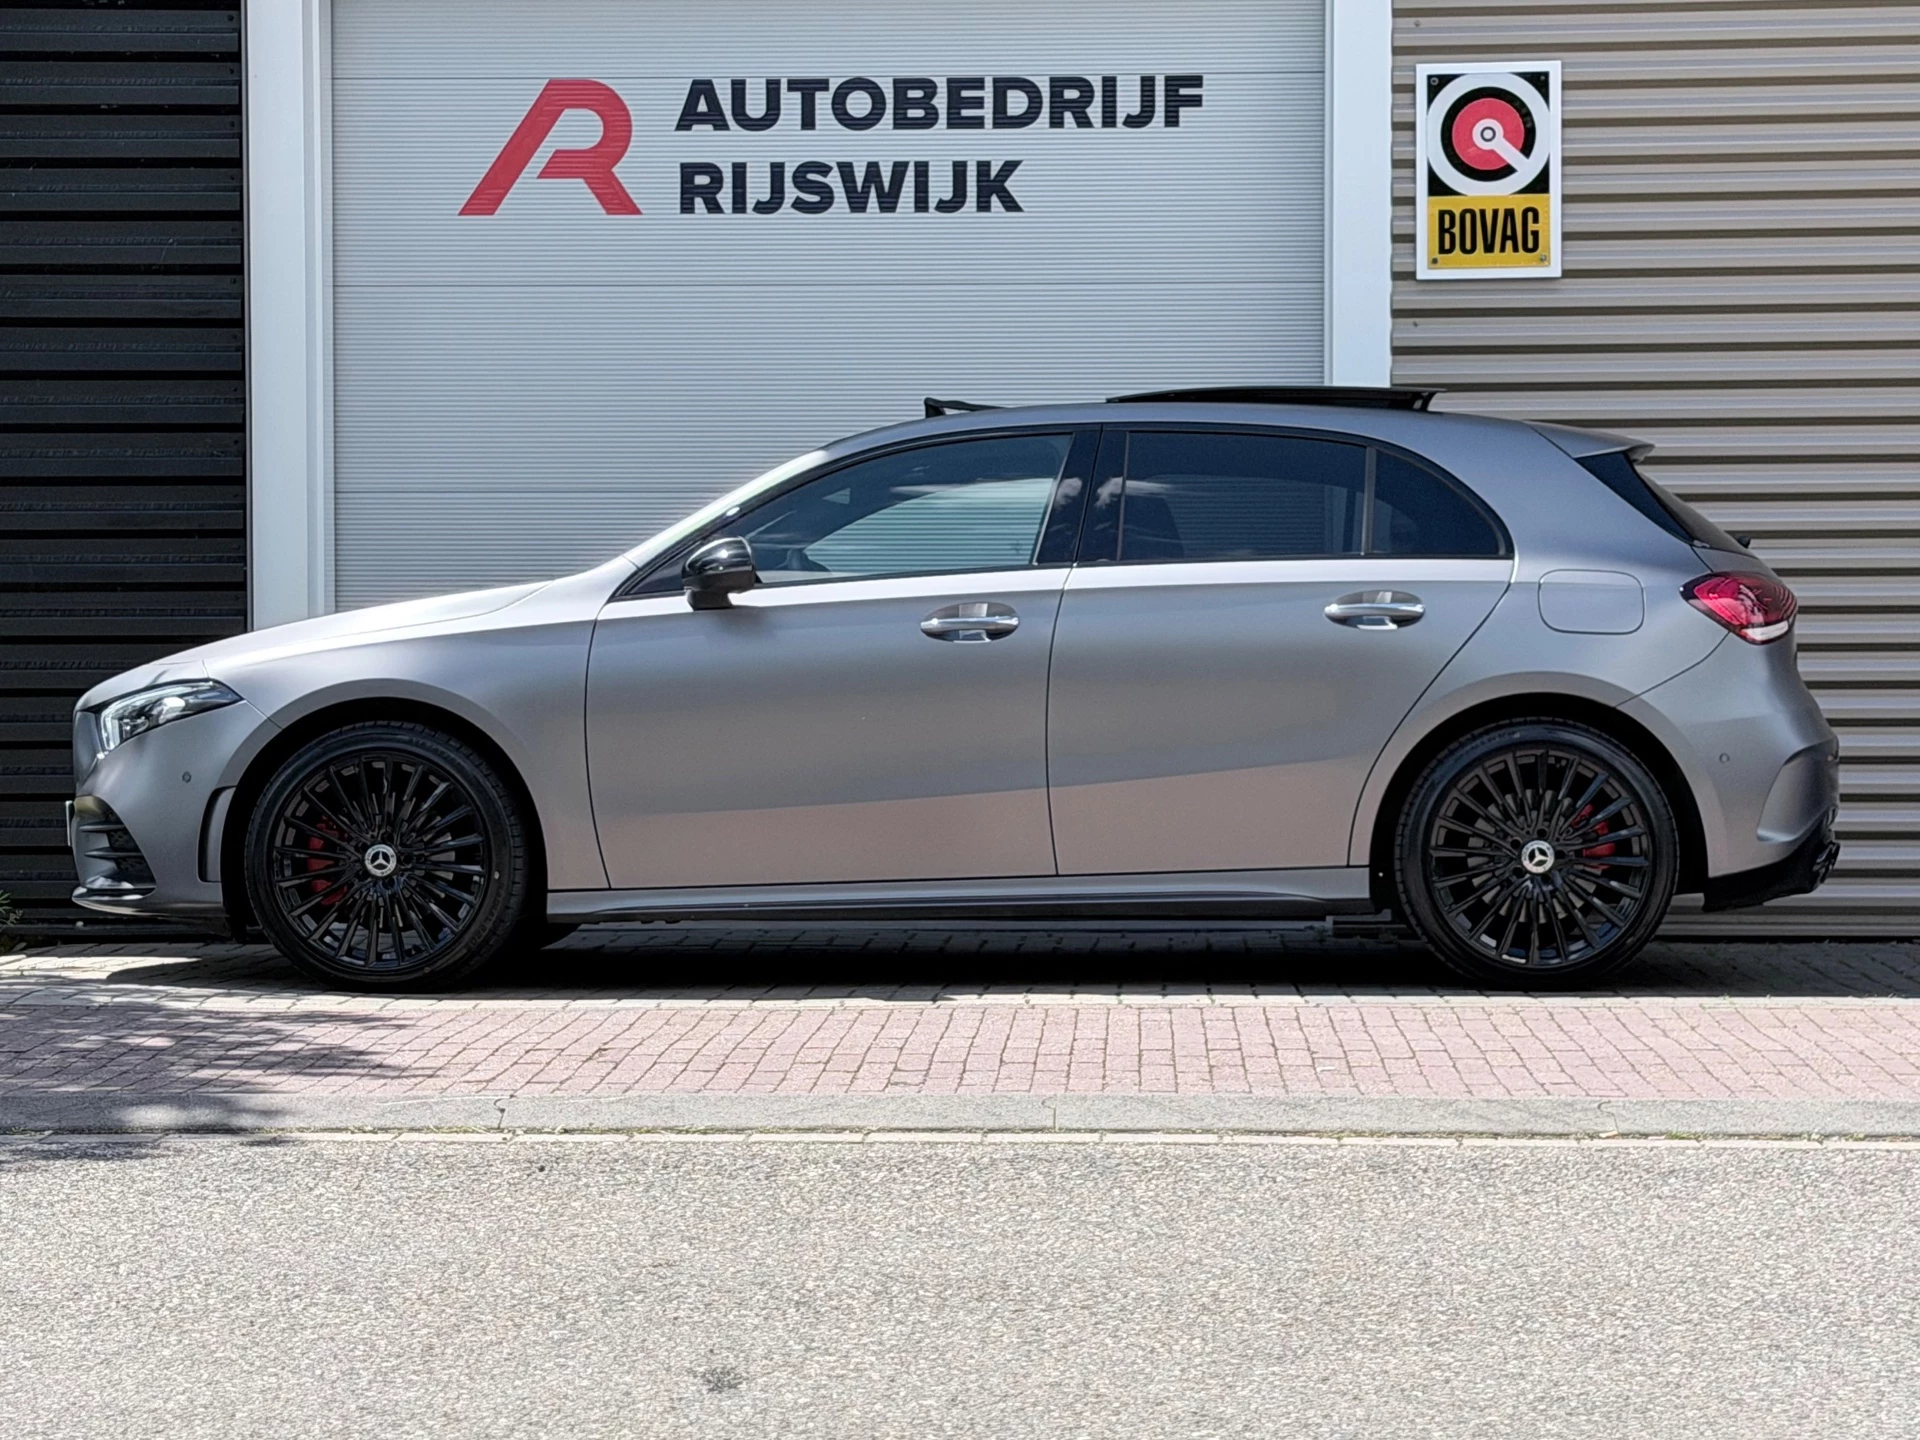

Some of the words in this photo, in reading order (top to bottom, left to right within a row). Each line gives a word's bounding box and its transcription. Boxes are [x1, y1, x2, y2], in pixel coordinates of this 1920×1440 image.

[674, 75, 1204, 131] AUTOBEDRIJF
[680, 160, 1023, 214] RIJSWIJK
[1438, 207, 1539, 254] BOVAG
